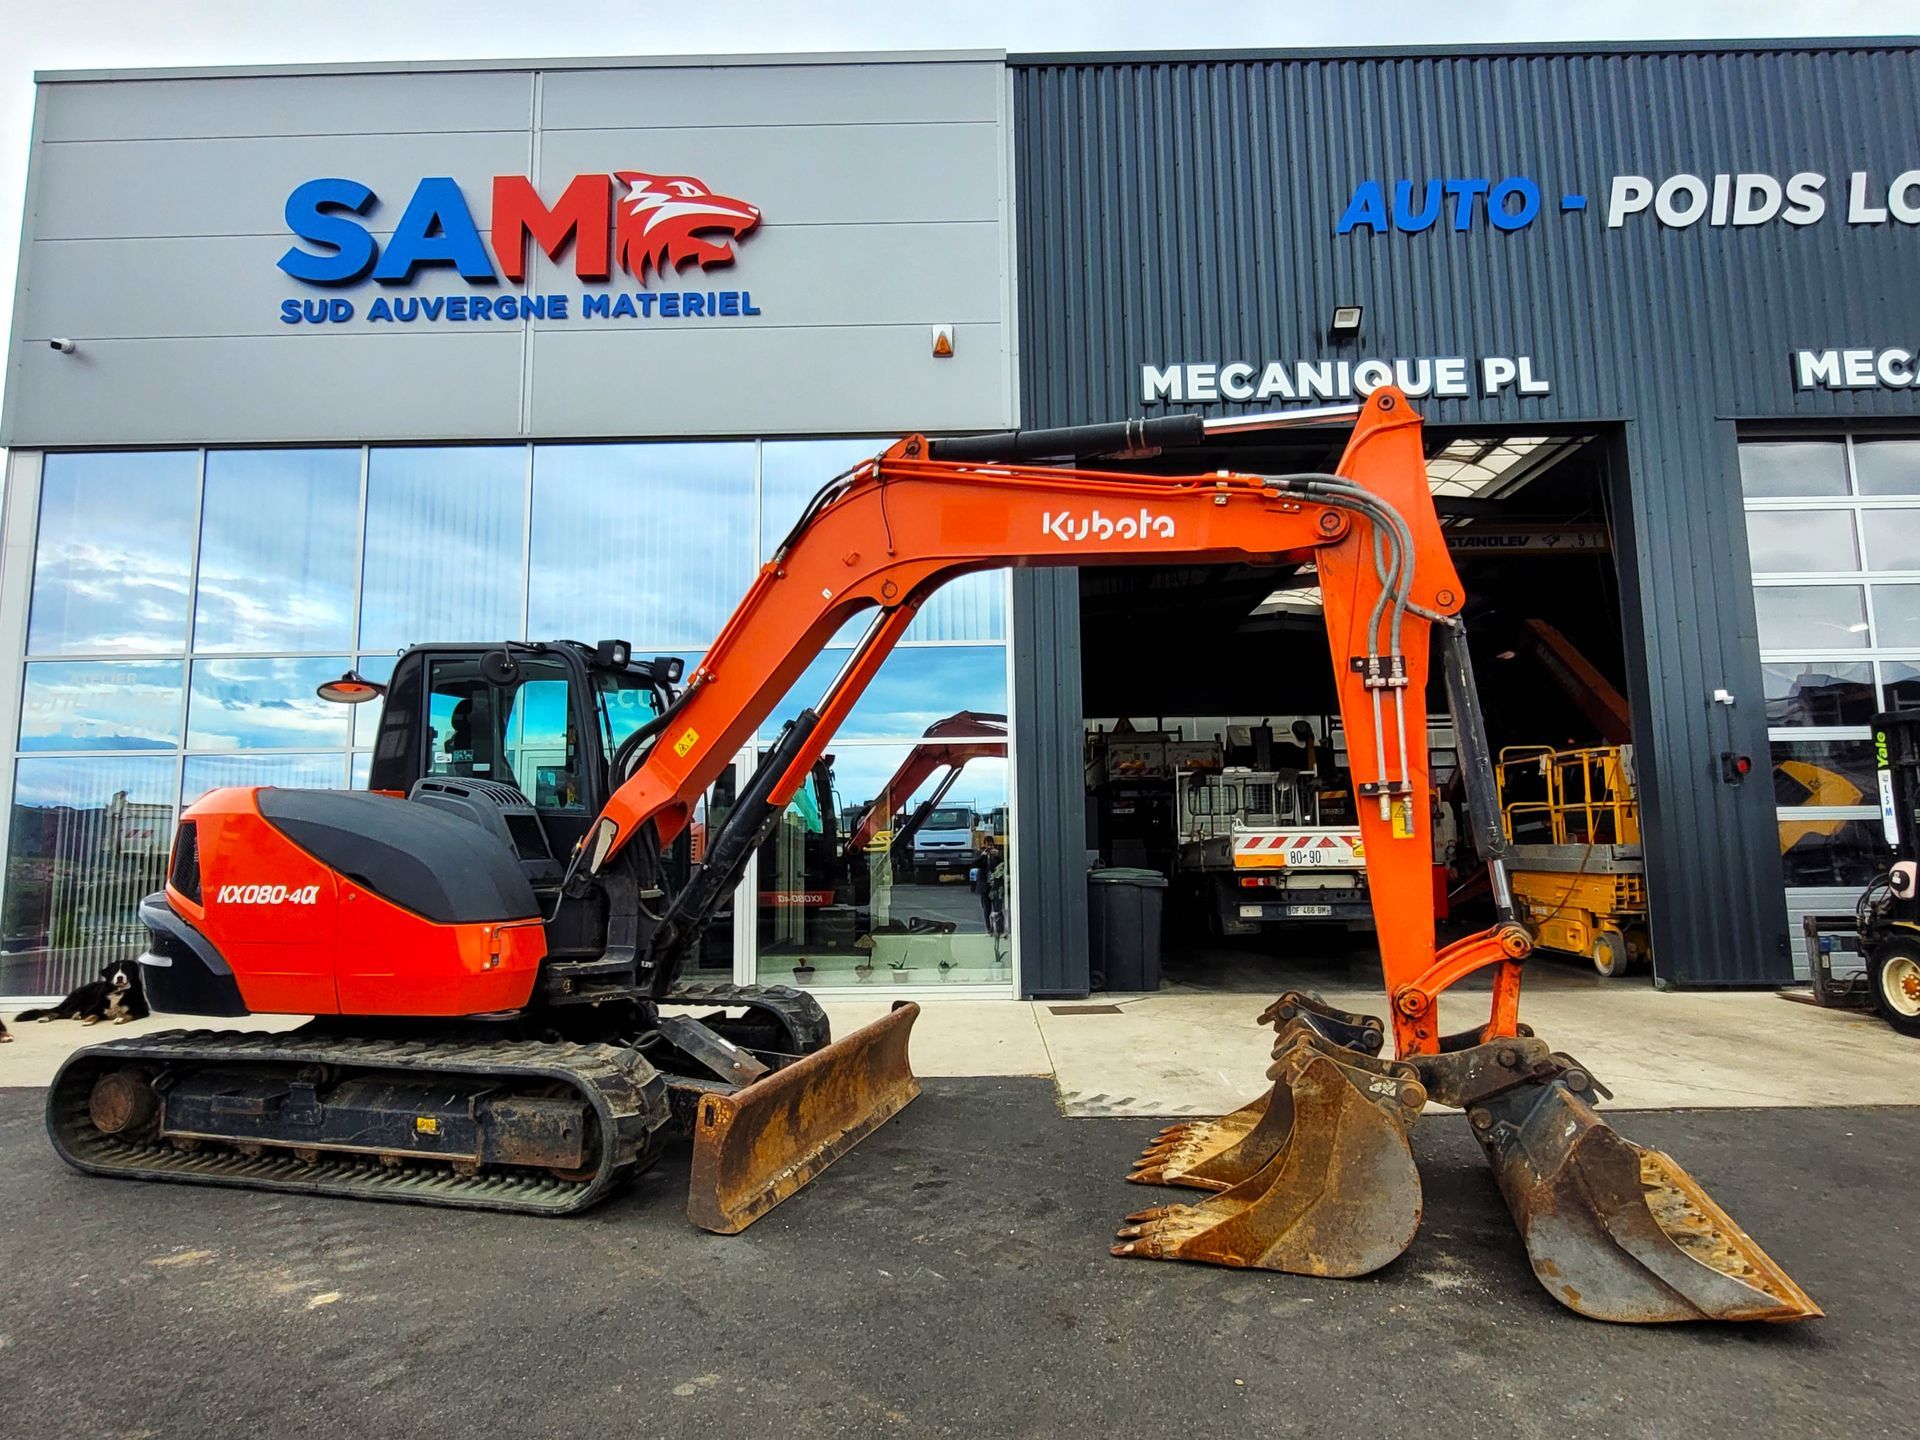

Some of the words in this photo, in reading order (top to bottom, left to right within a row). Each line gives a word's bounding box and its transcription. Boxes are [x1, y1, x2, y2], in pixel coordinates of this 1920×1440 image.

[1335, 175, 1541, 234] AUTO
[1607, 172, 1826, 228] POIDS
[276, 174, 612, 286] SAM
[280, 299, 355, 325] SUD
[366, 295, 569, 322] AUVERGNE
[582, 291, 761, 319] MATERIEL
[1142, 358, 1468, 400] MECANIQUE
[1484, 356, 1550, 393] PL
[1798, 349, 1920, 387] MEC
[1042, 508, 1175, 541] Kubota
[1875, 731, 1889, 768] Yale
